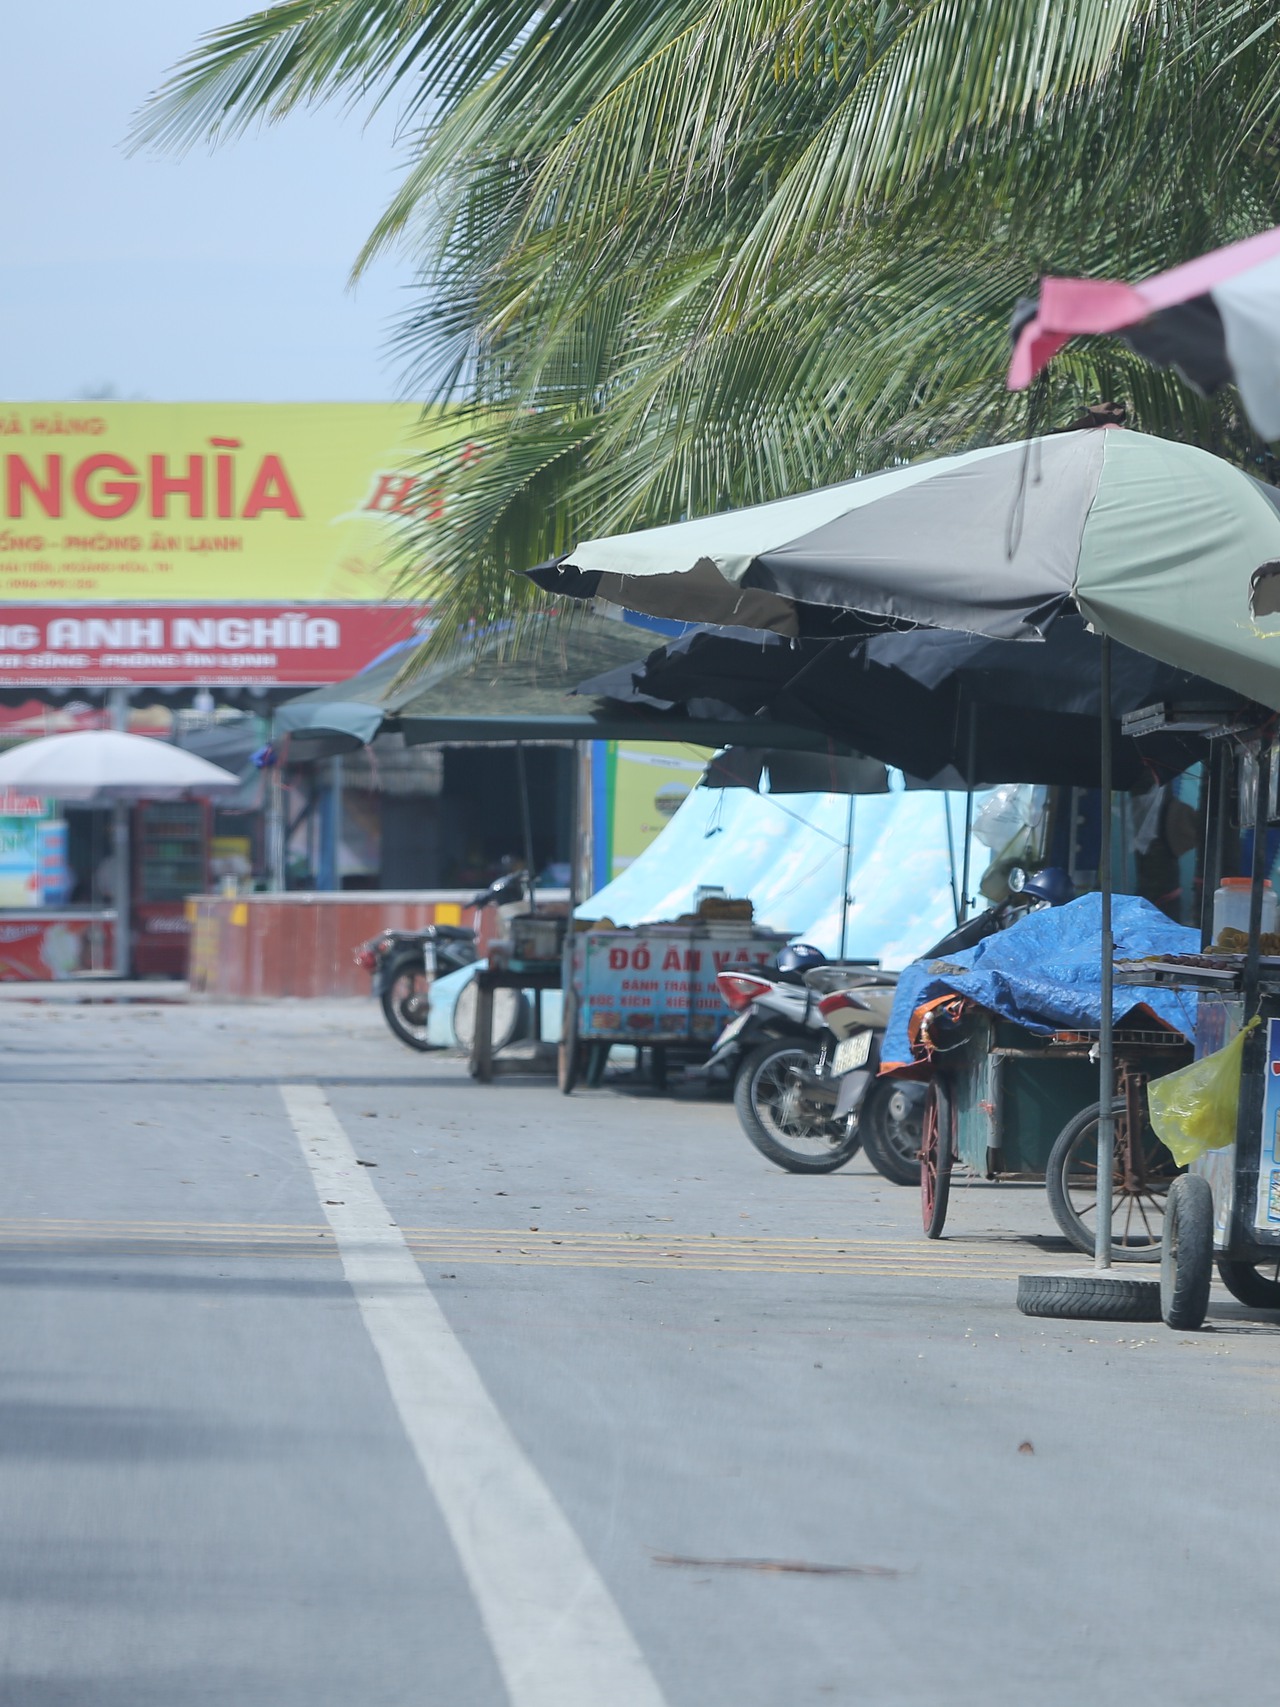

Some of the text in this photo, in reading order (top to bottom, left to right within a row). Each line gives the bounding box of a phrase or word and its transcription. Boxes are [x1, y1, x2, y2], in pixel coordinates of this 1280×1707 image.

[6, 436, 305, 520] NGHĨA
[46, 617, 164, 649] ANH
[171, 612, 341, 650] NGHĨA
[662, 945, 701, 971] ĂN
